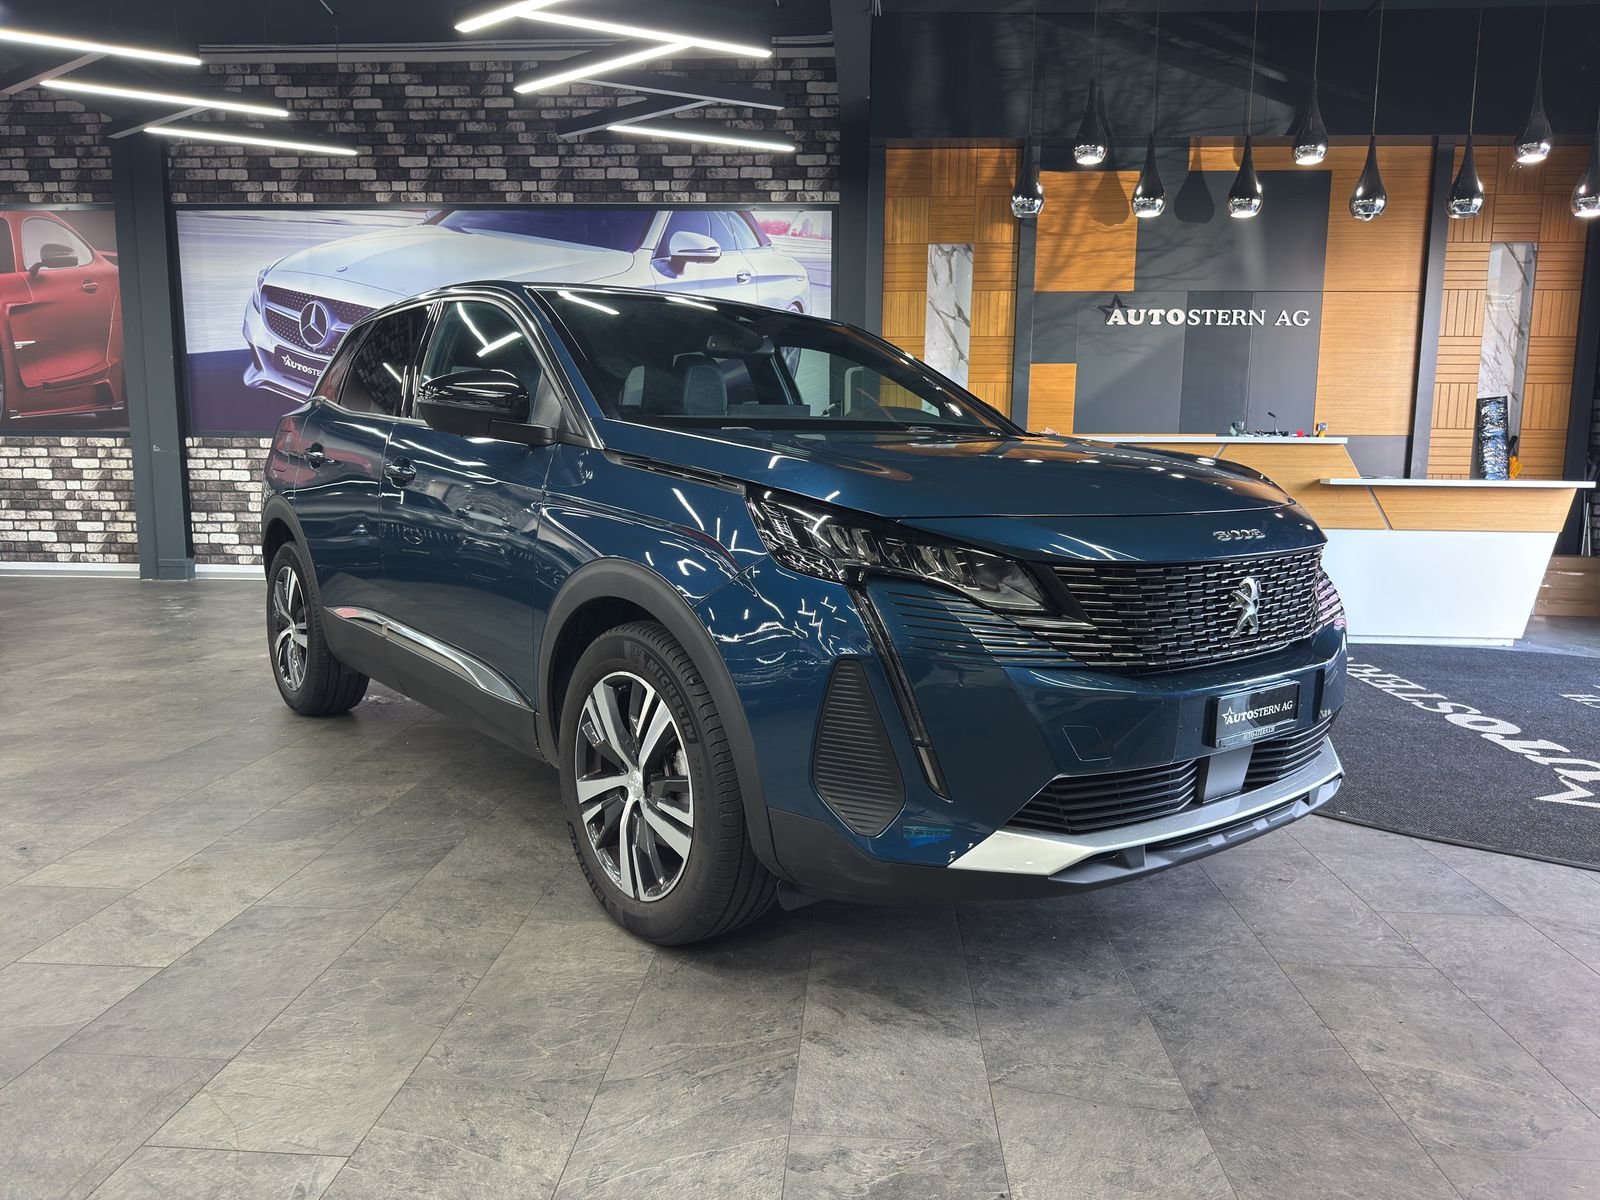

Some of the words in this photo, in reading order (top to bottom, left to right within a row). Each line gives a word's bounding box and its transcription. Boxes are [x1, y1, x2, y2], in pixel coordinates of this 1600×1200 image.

[1105, 308, 1266, 326] AUTOSTERN
[1274, 309, 1311, 327] AG
[646, 658, 698, 740] MICHELIN
[1225, 703, 1281, 725] AUTOSTERN
[1281, 700, 1294, 712] AG
